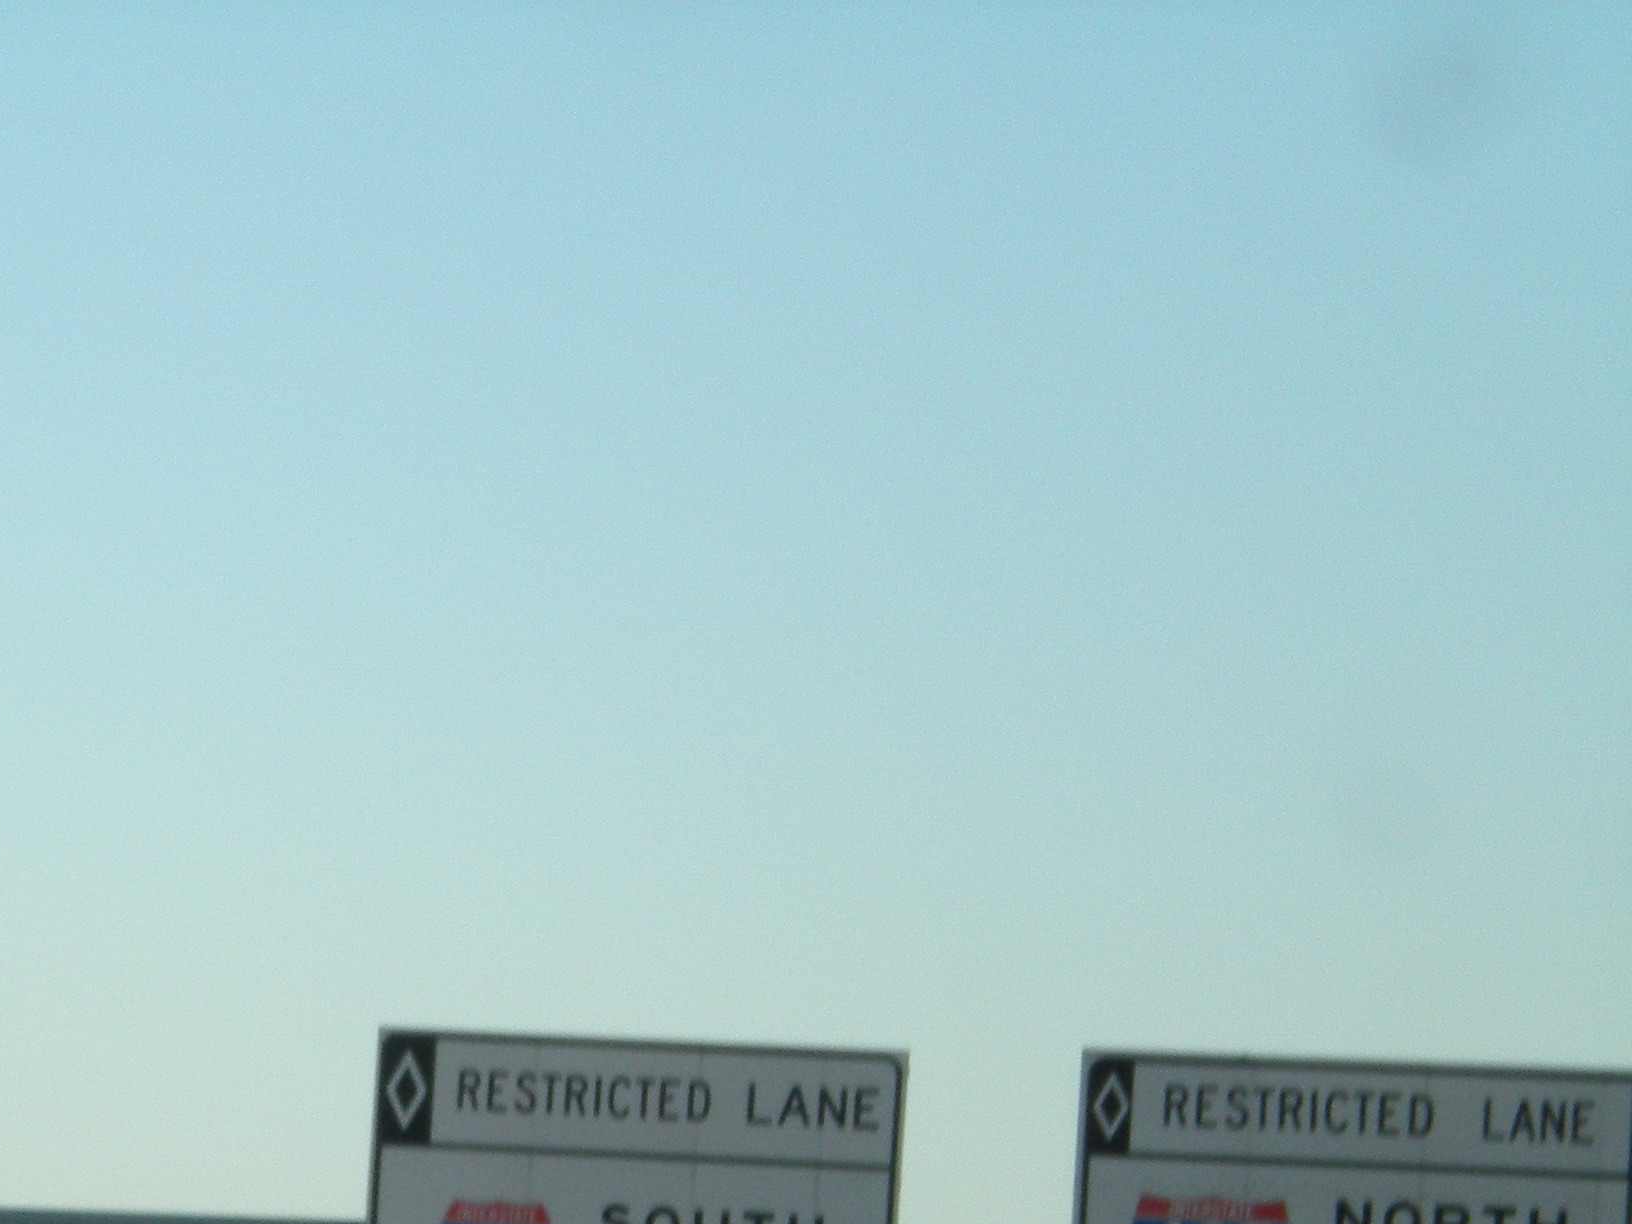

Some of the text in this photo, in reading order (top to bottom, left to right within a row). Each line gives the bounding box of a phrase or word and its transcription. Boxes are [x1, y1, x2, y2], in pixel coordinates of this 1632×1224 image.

[456, 1069, 880, 1131] RESTRICTED LANE
[1163, 1083, 1595, 1147] RESTRICTED LANE
